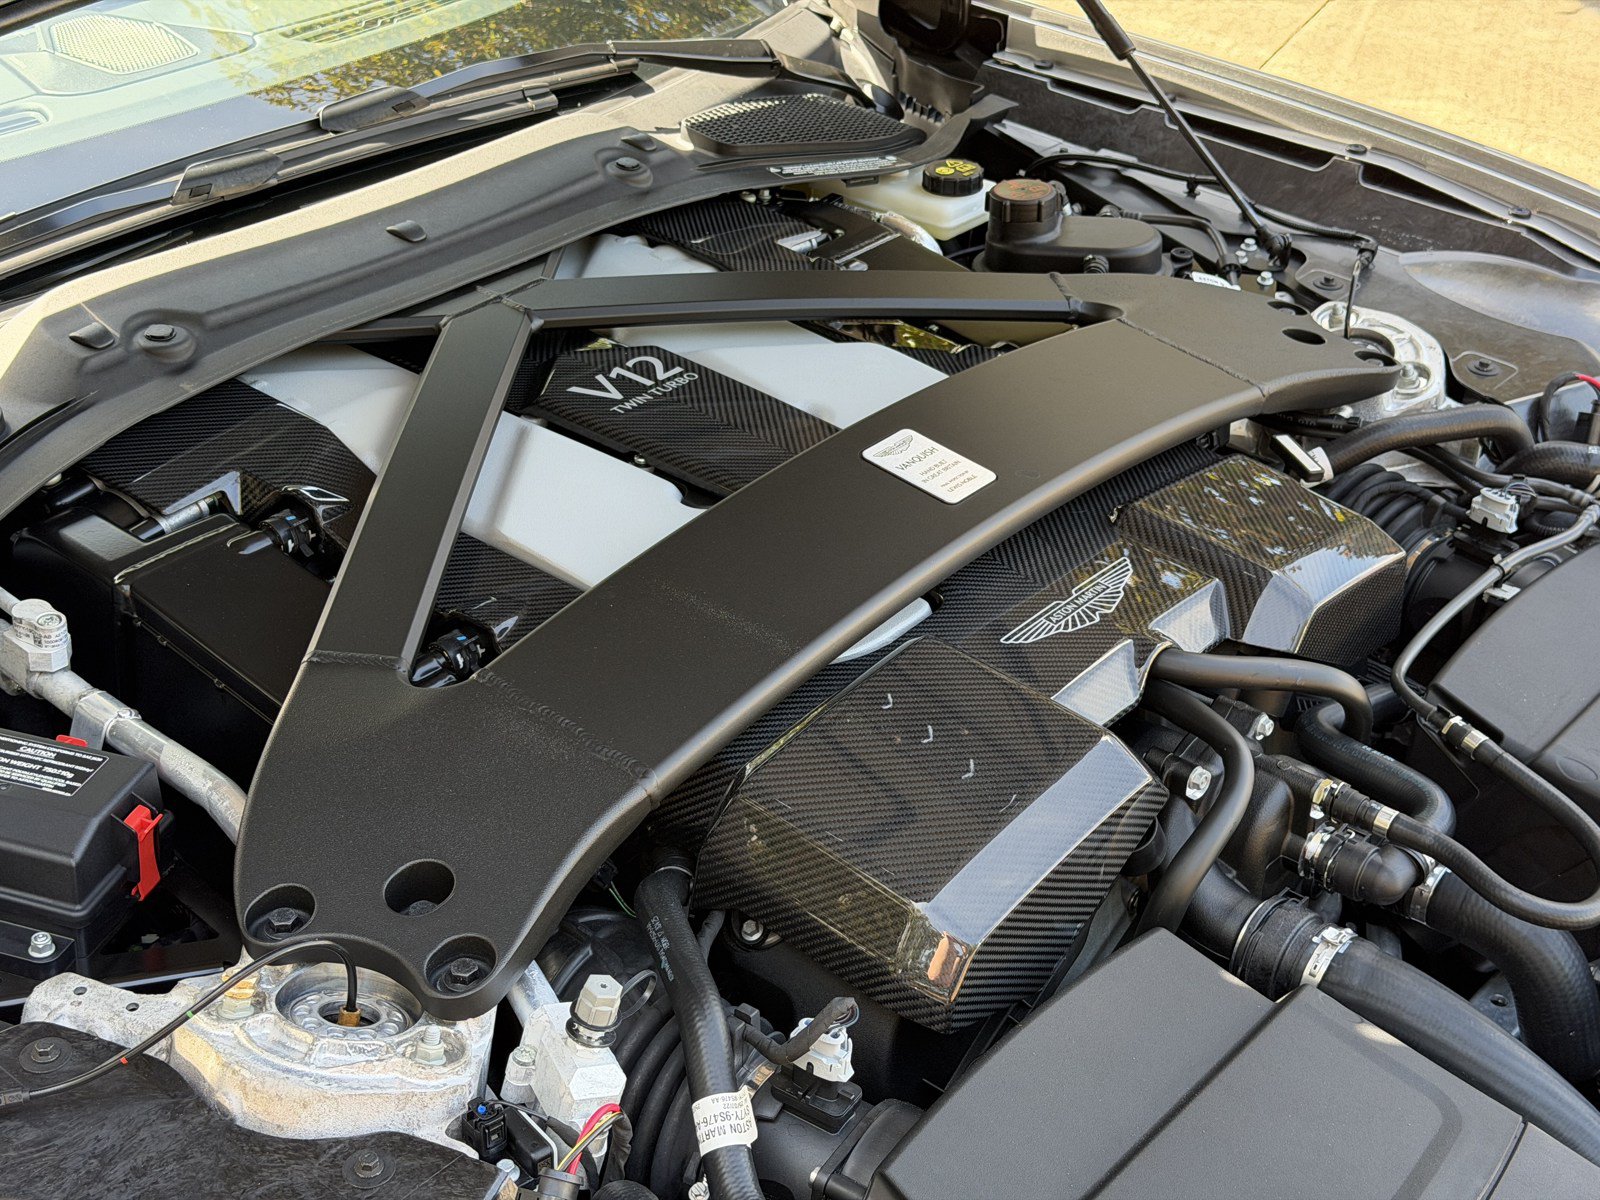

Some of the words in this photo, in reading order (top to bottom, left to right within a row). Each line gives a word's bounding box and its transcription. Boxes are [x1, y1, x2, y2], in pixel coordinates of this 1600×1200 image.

[566, 355, 684, 400] V12
[609, 393, 654, 414] TWIN
[647, 372, 699, 396] TURBO
[894, 445, 940, 471] VANQUISH
[1049, 601, 1078, 625] ASTON
[1075, 583, 1107, 606] MARTIN
[9, 759, 43, 771] WEIGHT
[18, 745, 58, 759] CAUTION
